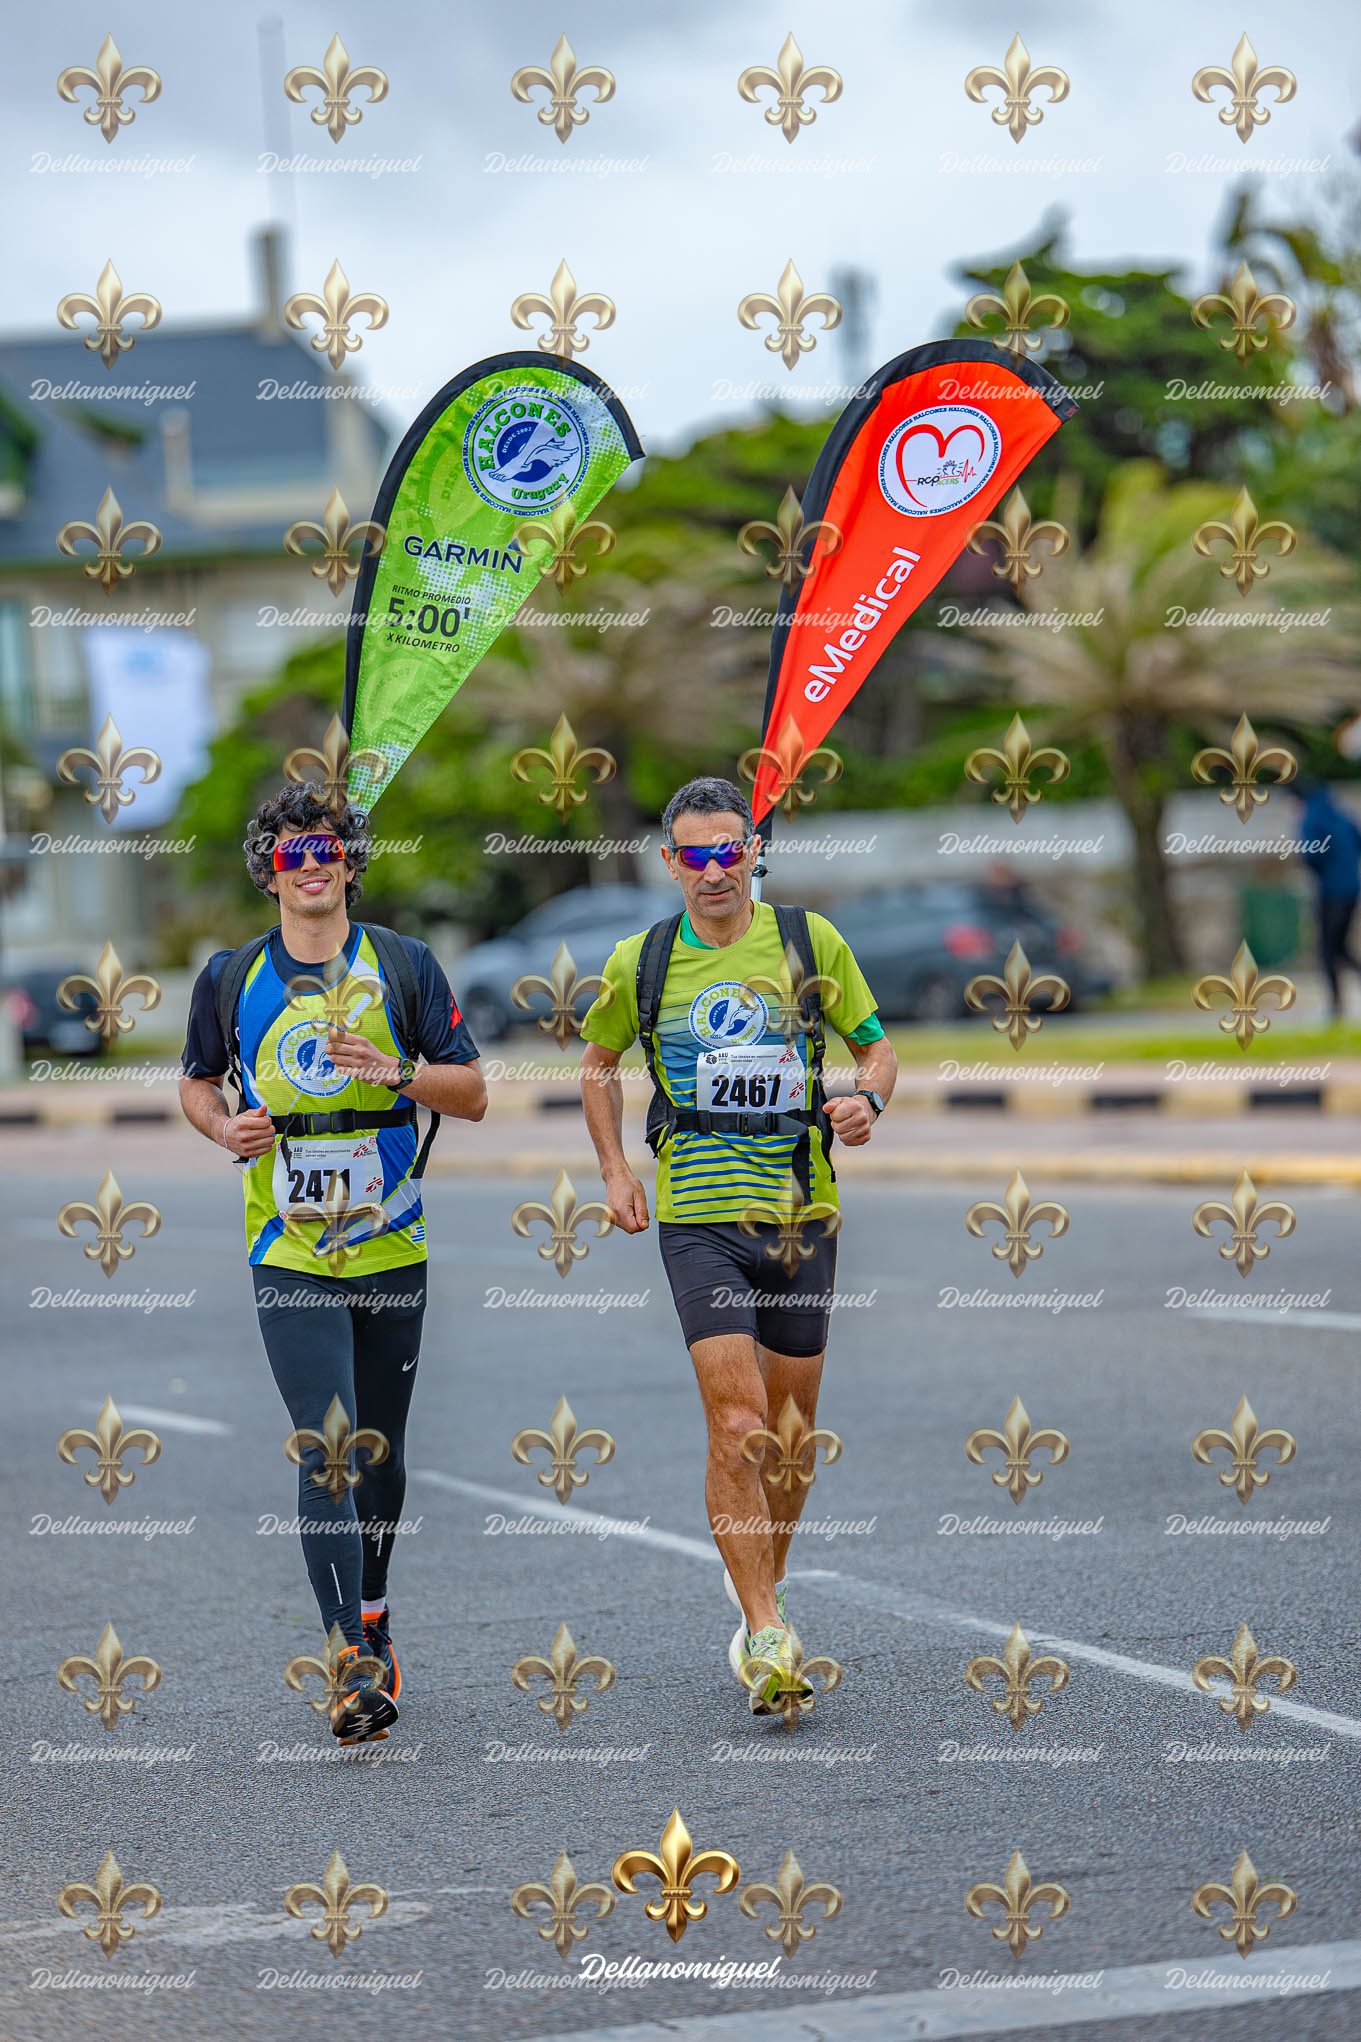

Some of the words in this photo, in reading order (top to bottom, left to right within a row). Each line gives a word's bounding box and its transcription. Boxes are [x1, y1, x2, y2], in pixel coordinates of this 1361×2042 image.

[478, 402, 571, 470] HALCONES
[511, 473, 569, 500] Uruguay
[404, 535, 522, 574] GARMIN
[392, 584, 420, 598] RITMO
[422, 591, 471, 604] PROMEDIO
[804, 546, 920, 702] eMedical
[386, 632, 394, 642] X
[394, 633, 460, 652] KILOMETRO
[712, 1074, 782, 1108] 2467
[288, 1168, 350, 1203] 2471
